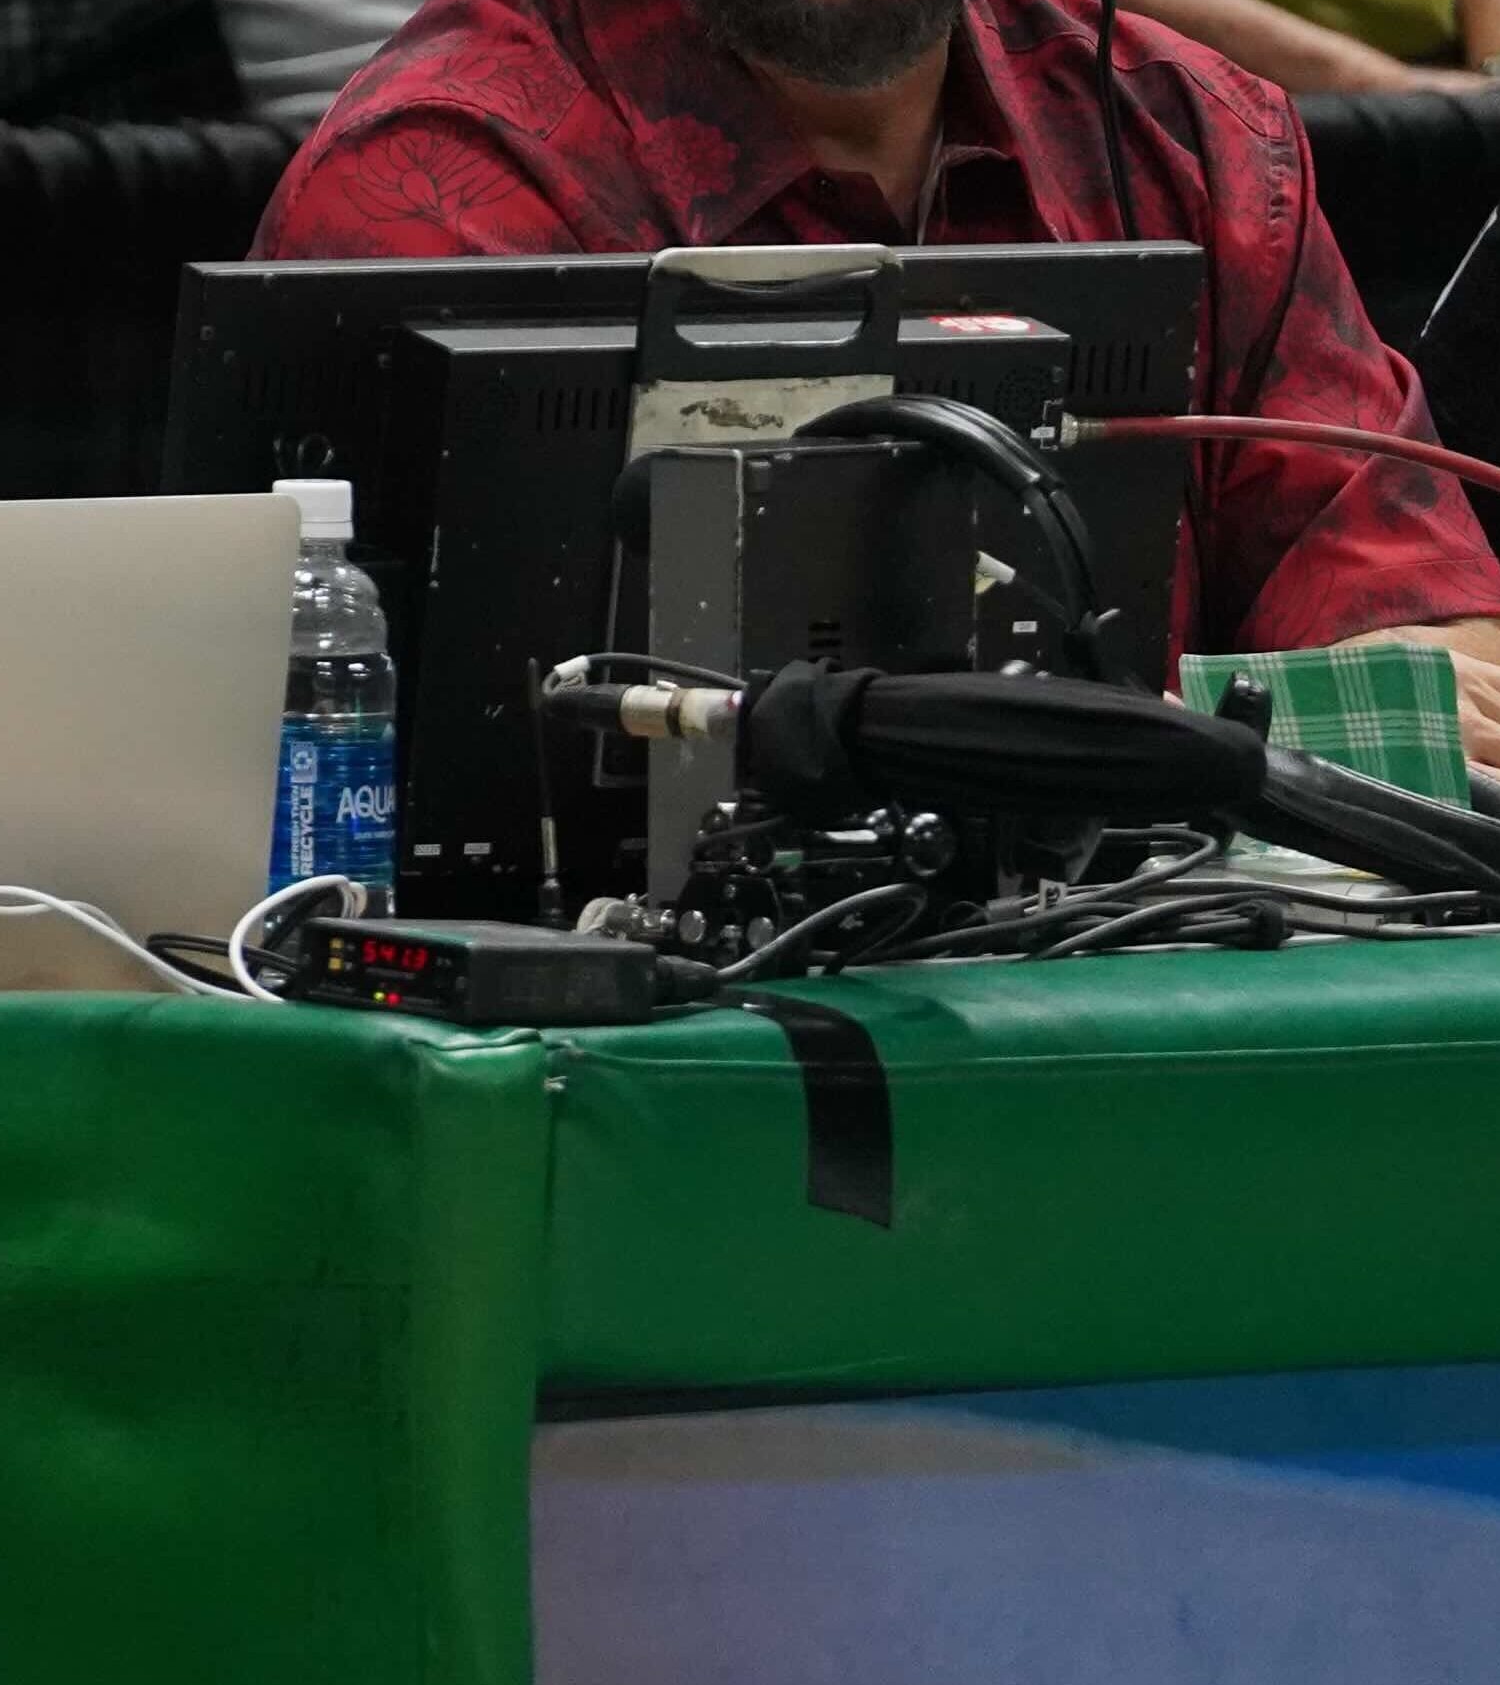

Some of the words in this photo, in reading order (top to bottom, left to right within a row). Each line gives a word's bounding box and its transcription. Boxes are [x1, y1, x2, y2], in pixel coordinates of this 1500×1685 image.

[290, 785, 300, 818] THEN
[290, 821, 300, 876] REFRESH
[300, 786, 314, 876] RECYCLE
